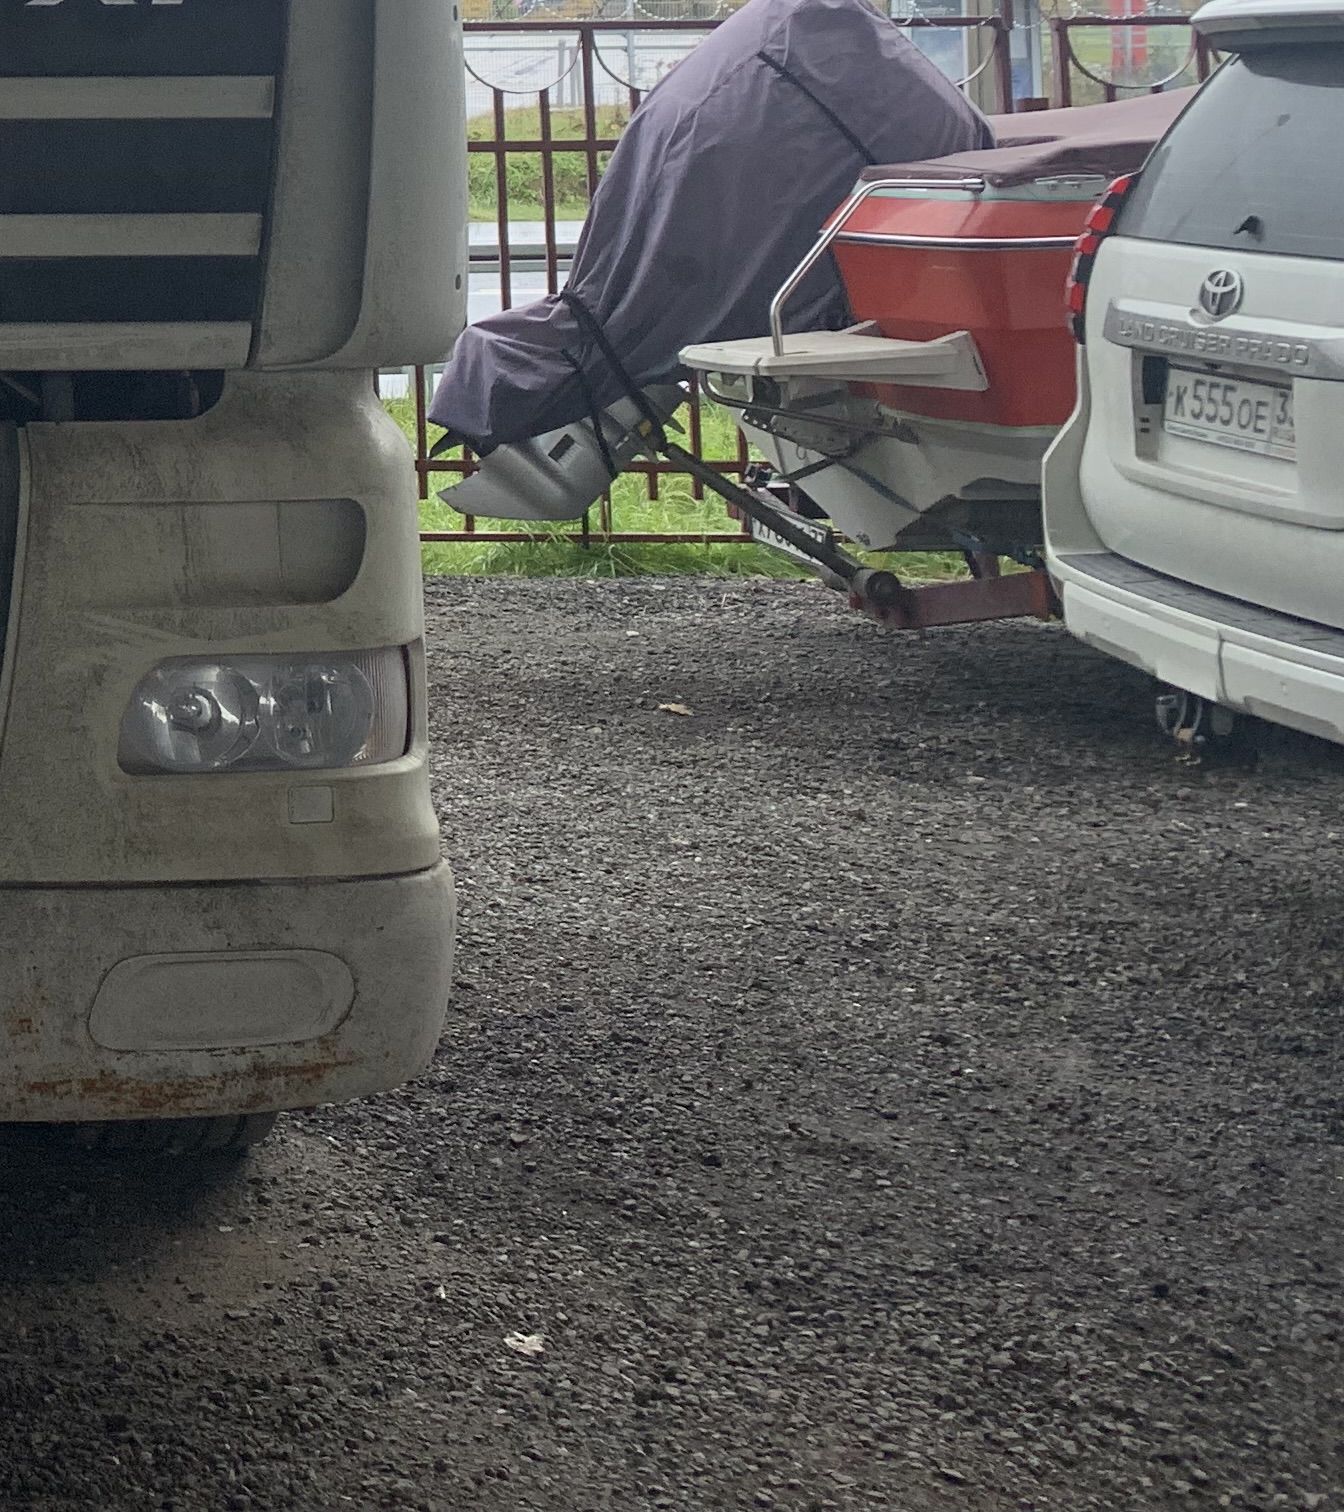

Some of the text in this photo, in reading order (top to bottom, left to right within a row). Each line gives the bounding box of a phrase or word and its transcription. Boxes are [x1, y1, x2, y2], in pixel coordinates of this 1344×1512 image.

[1159, 325, 1231, 354] CRUISER
[1236, 337, 1310, 366] PRADO
[1276, 392, 1295, 427] 3
